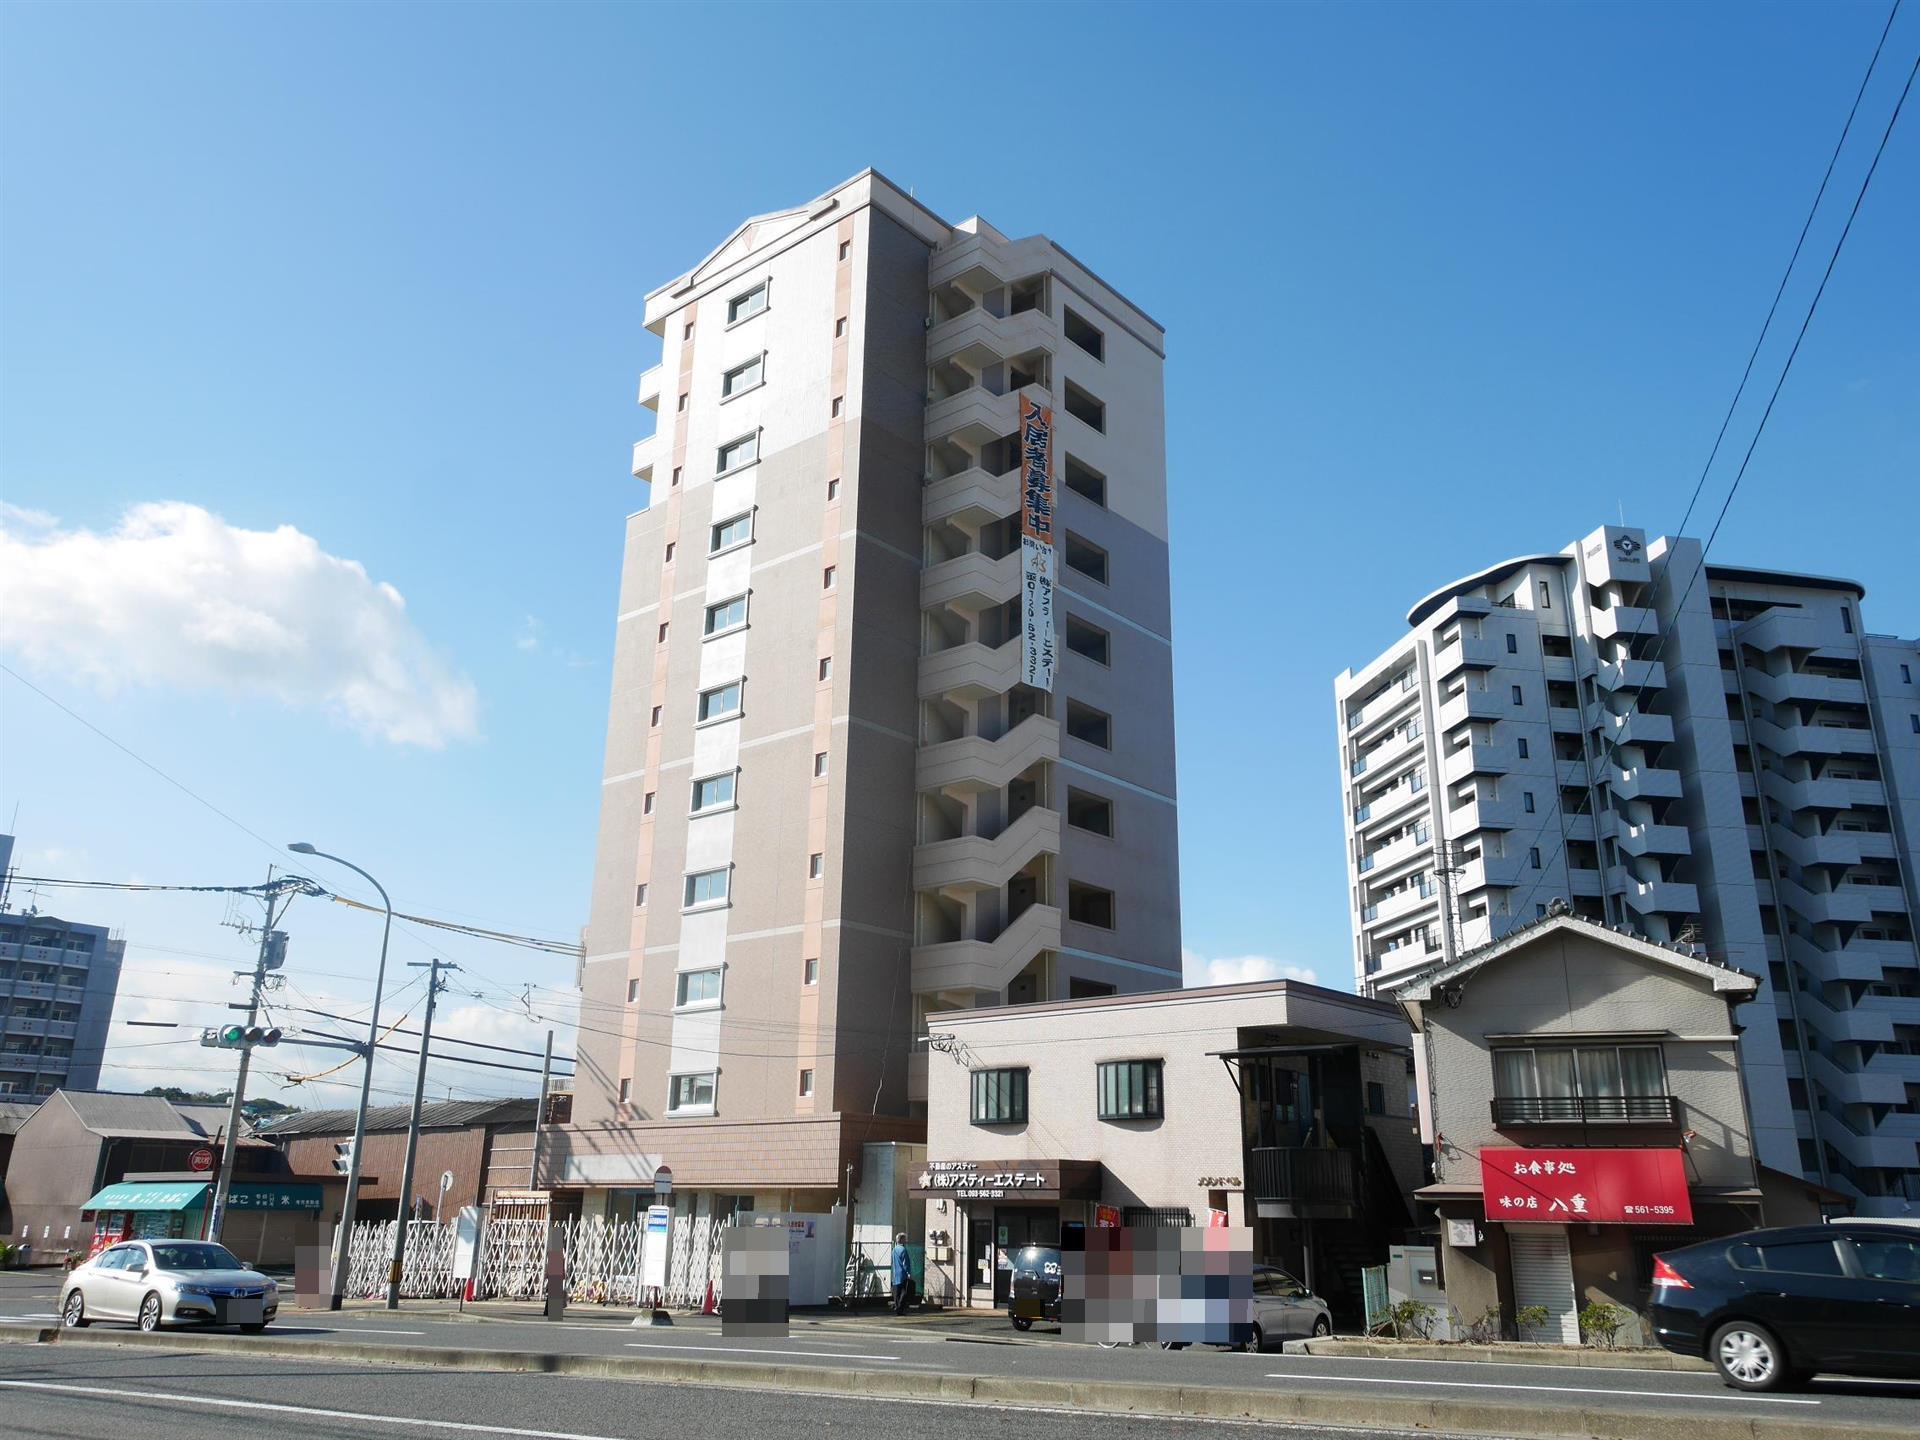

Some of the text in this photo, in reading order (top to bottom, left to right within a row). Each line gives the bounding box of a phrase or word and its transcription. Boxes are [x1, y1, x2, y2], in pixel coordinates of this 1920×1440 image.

[1024, 401, 1051, 536] 入居者募集中
[1514, 1159, 1577, 1176] お食事処
[1499, 1193, 1589, 1214] 味の店 八重
[1635, 1206, 1675, 1215] 561-5395
